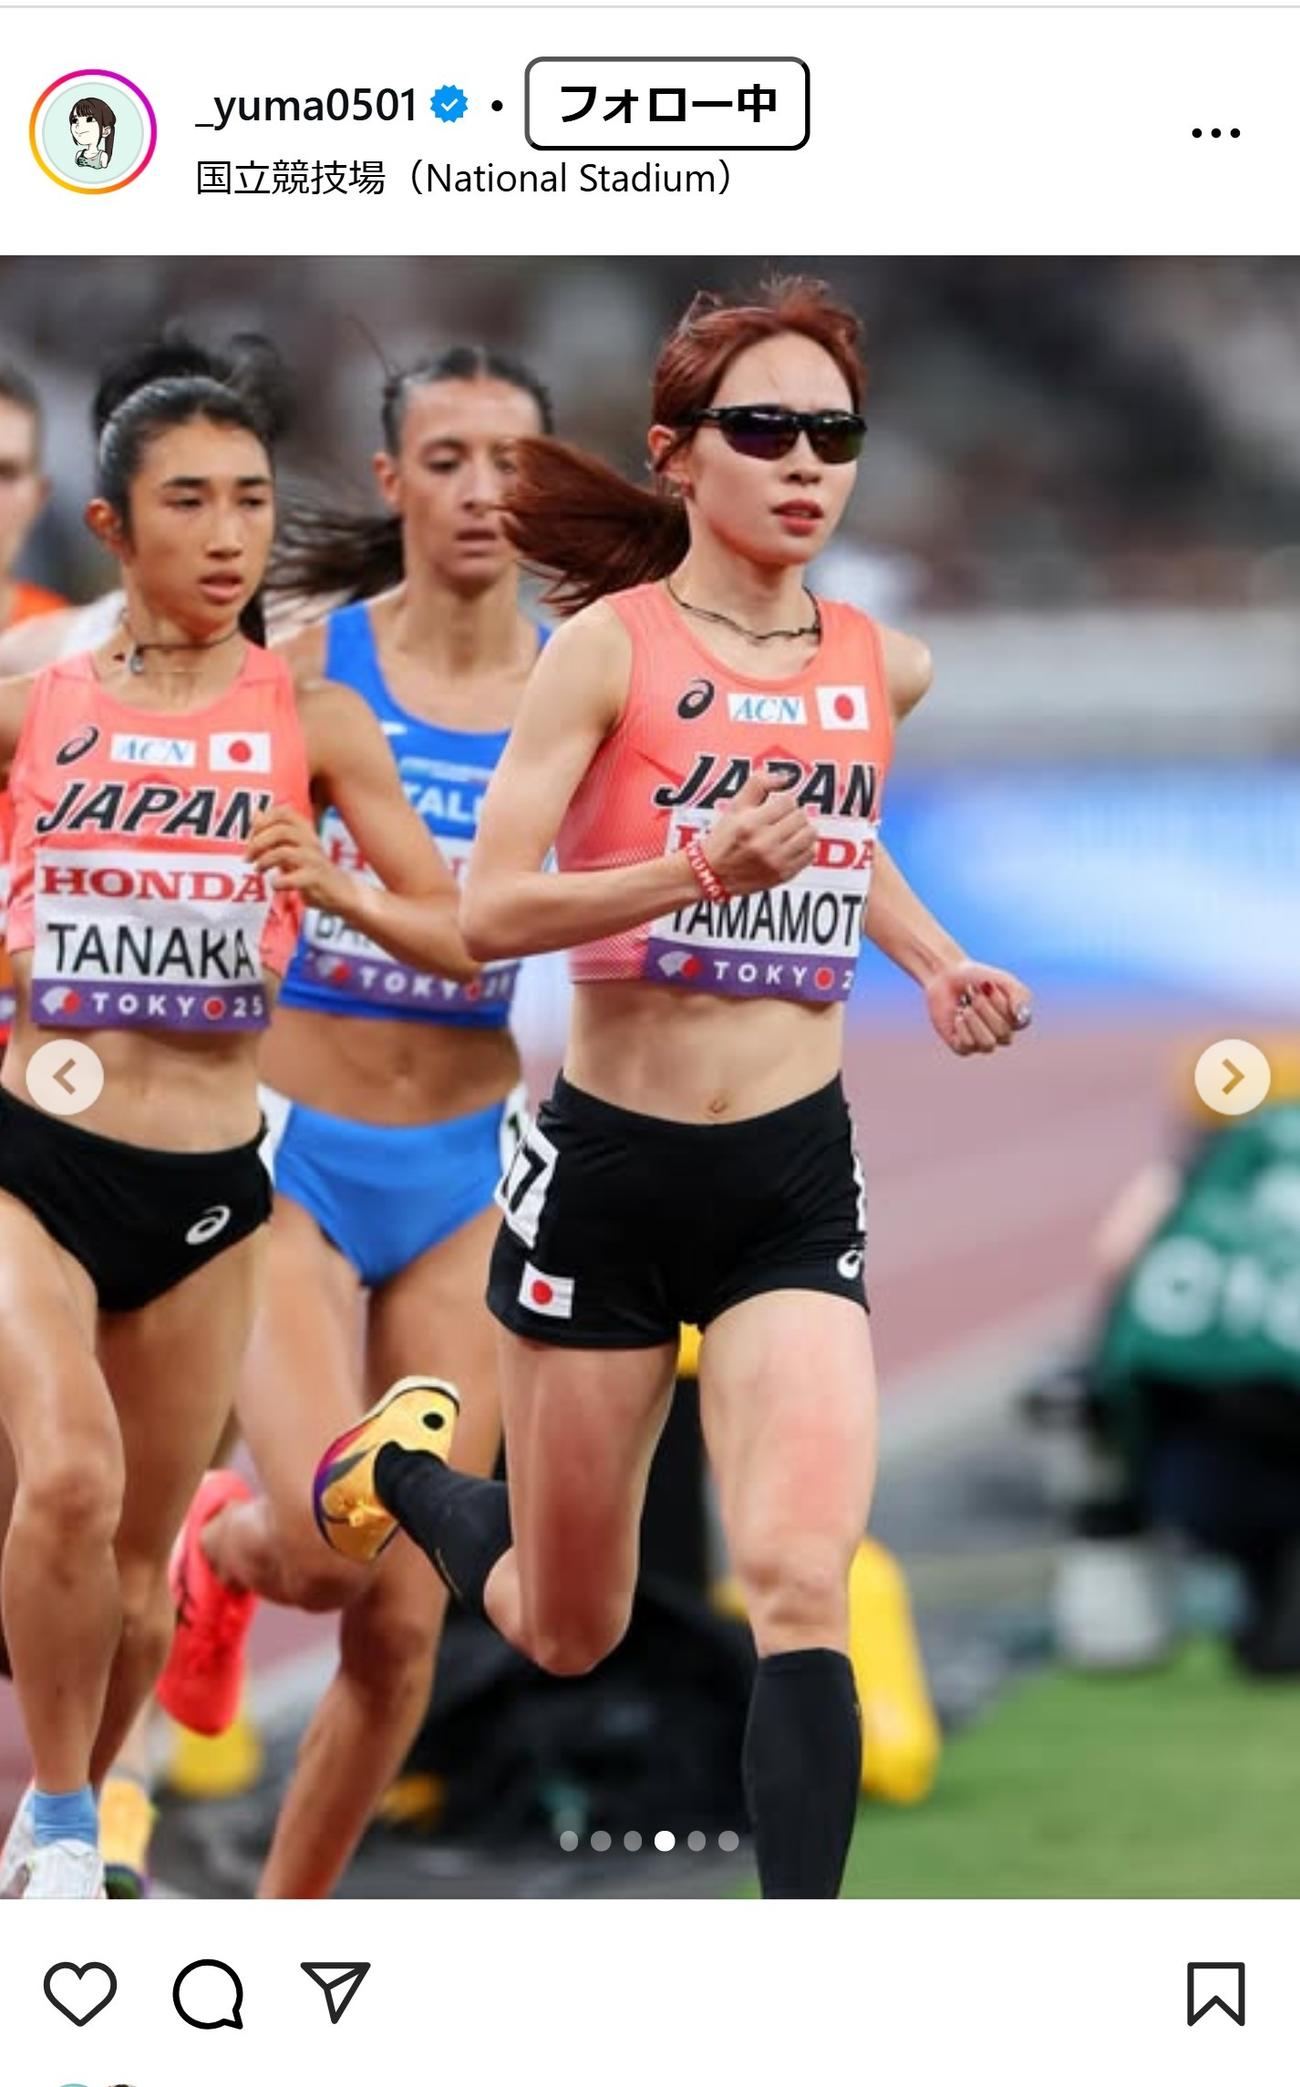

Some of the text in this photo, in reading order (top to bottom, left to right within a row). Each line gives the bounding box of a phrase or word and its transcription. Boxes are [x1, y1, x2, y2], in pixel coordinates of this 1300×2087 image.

[734, 697, 799, 721] ACN
[40, 865, 268, 904] HONDA
[46, 923, 257, 980] TANAKA
